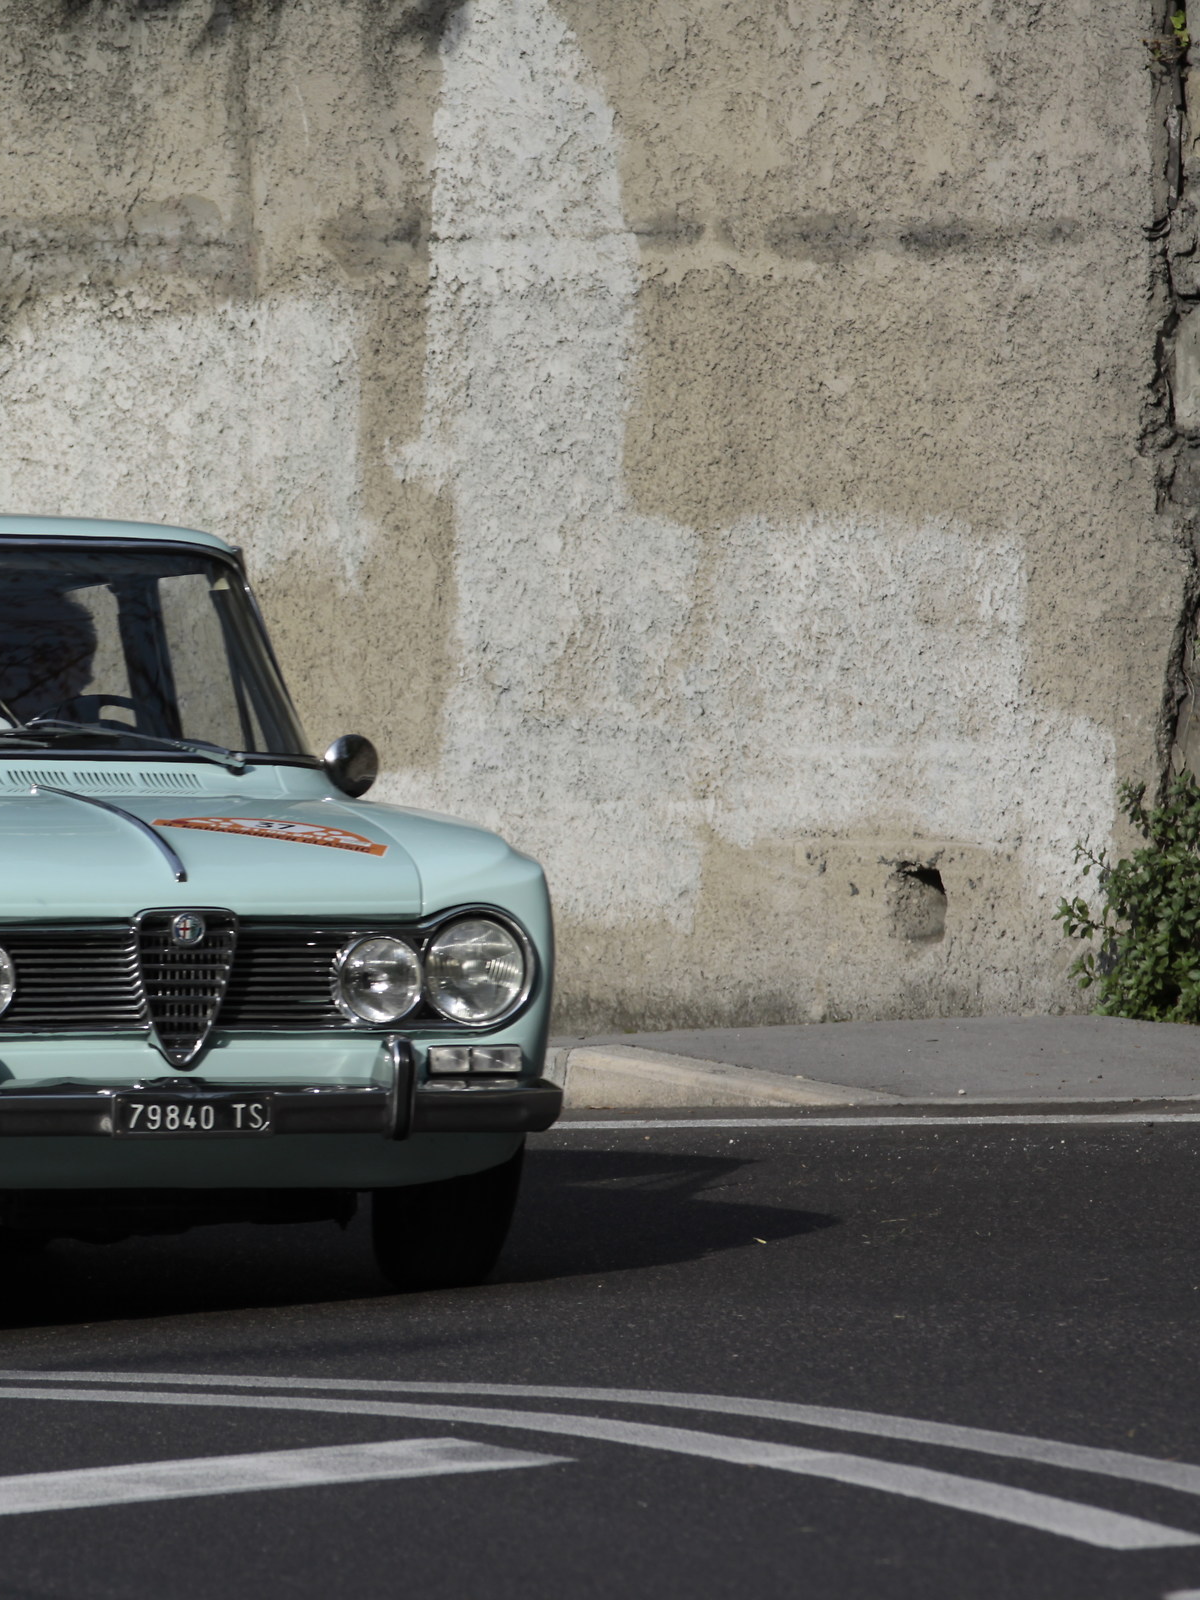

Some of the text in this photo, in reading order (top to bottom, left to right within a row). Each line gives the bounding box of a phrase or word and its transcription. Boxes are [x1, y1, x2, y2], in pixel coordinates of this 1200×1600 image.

[254, 821, 297, 830] 37
[302, 837, 370, 853] CLASSIC
[129, 1103, 264, 1130] 79840 TS
